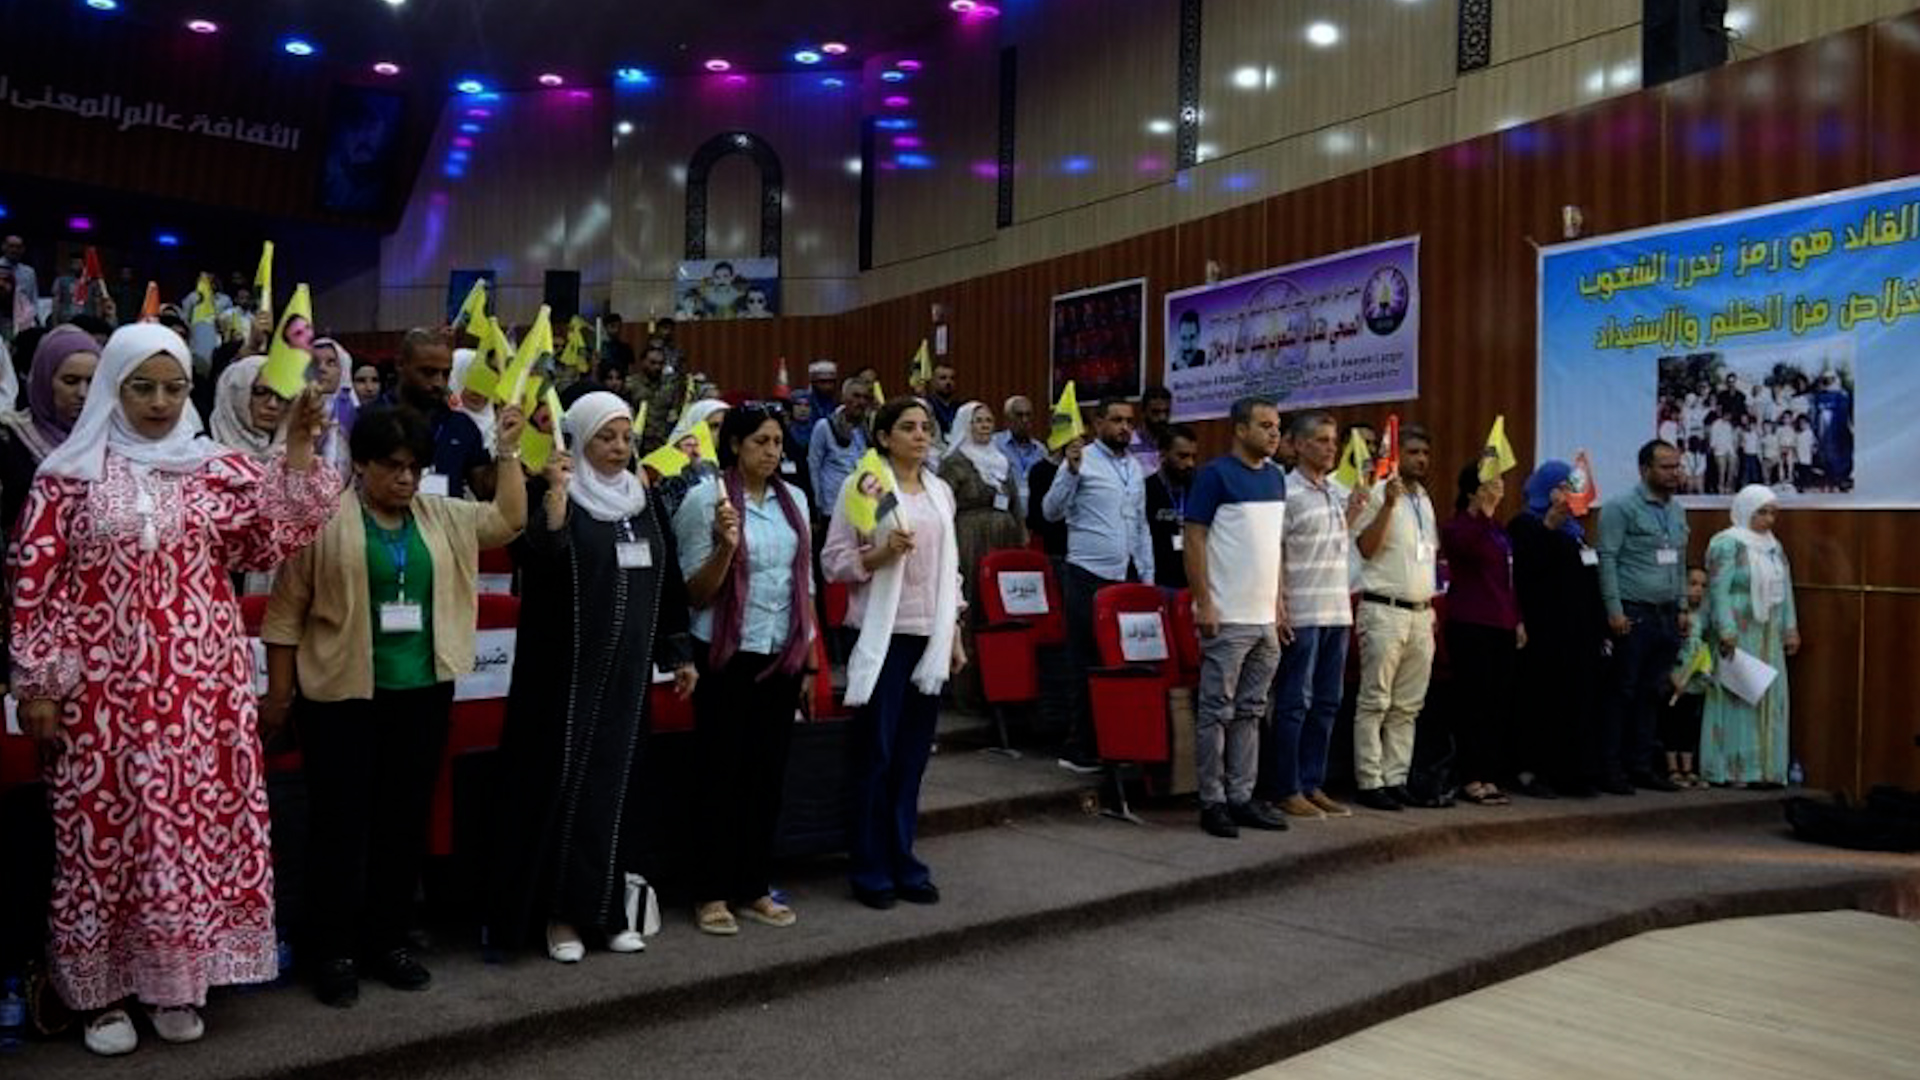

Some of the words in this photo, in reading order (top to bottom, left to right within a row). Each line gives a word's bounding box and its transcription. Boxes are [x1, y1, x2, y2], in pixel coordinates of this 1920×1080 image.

[117, 101, 184, 132] عالم
[187, 113, 301, 152] الثقافة
[1734, 238, 1780, 276] رمز
[1790, 230, 1833, 269] هو
[1579, 251, 1667, 301] الشعوب
[1705, 294, 1782, 345] الظلم
[1792, 296, 1829, 335] من
